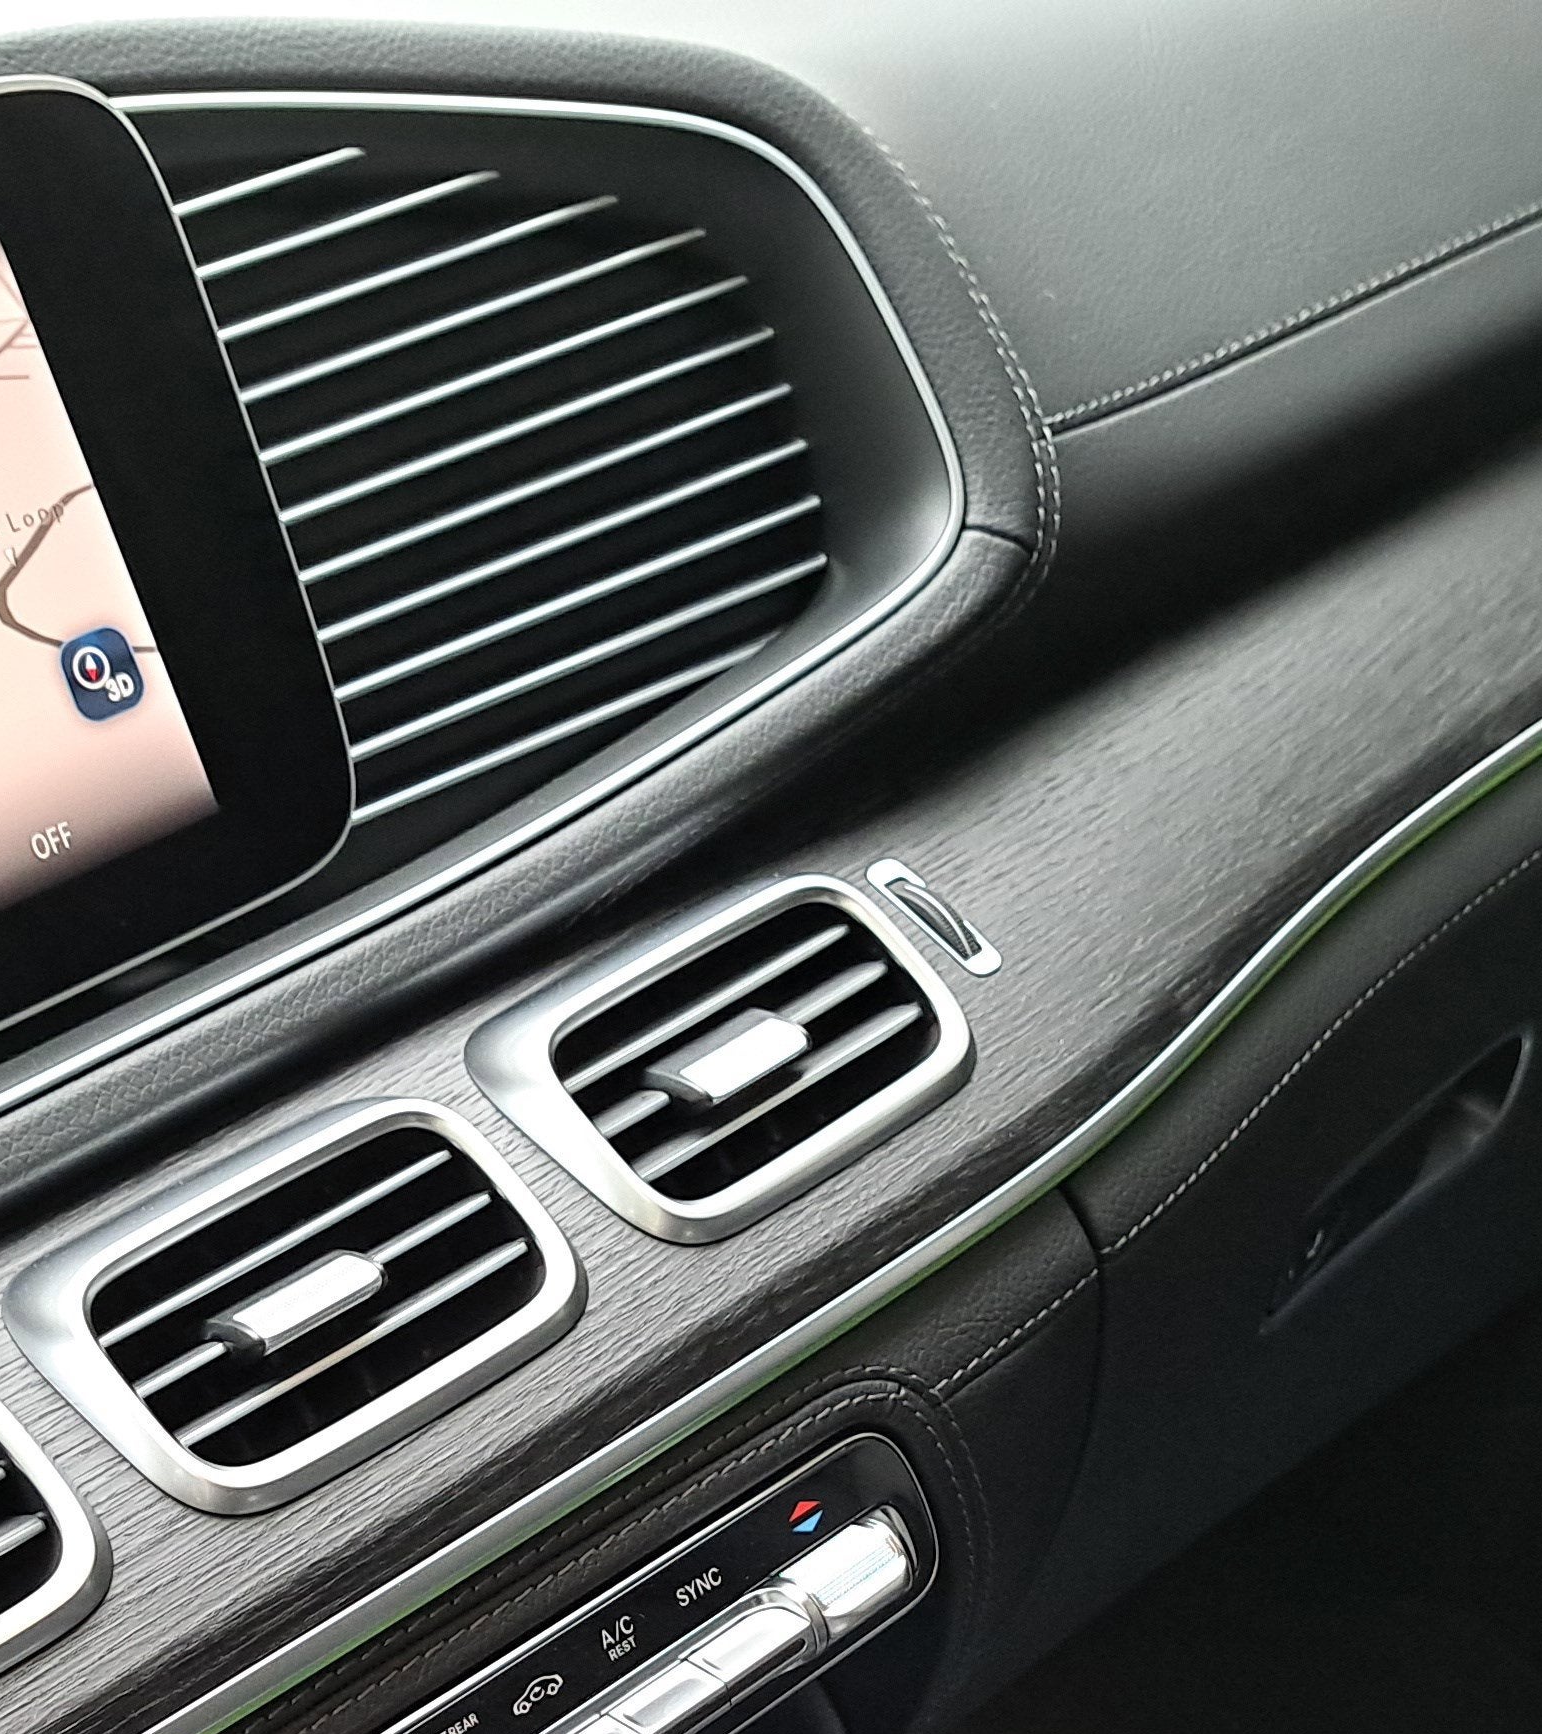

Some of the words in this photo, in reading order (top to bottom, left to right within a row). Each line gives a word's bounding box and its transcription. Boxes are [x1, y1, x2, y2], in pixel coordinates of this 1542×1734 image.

[6, 503, 64, 533] Loop
[31, 821, 72, 860] OFF
[675, 1567, 723, 1607] SYNC
[601, 1615, 634, 1650] A/C
[608, 1636, 637, 1661] REST
